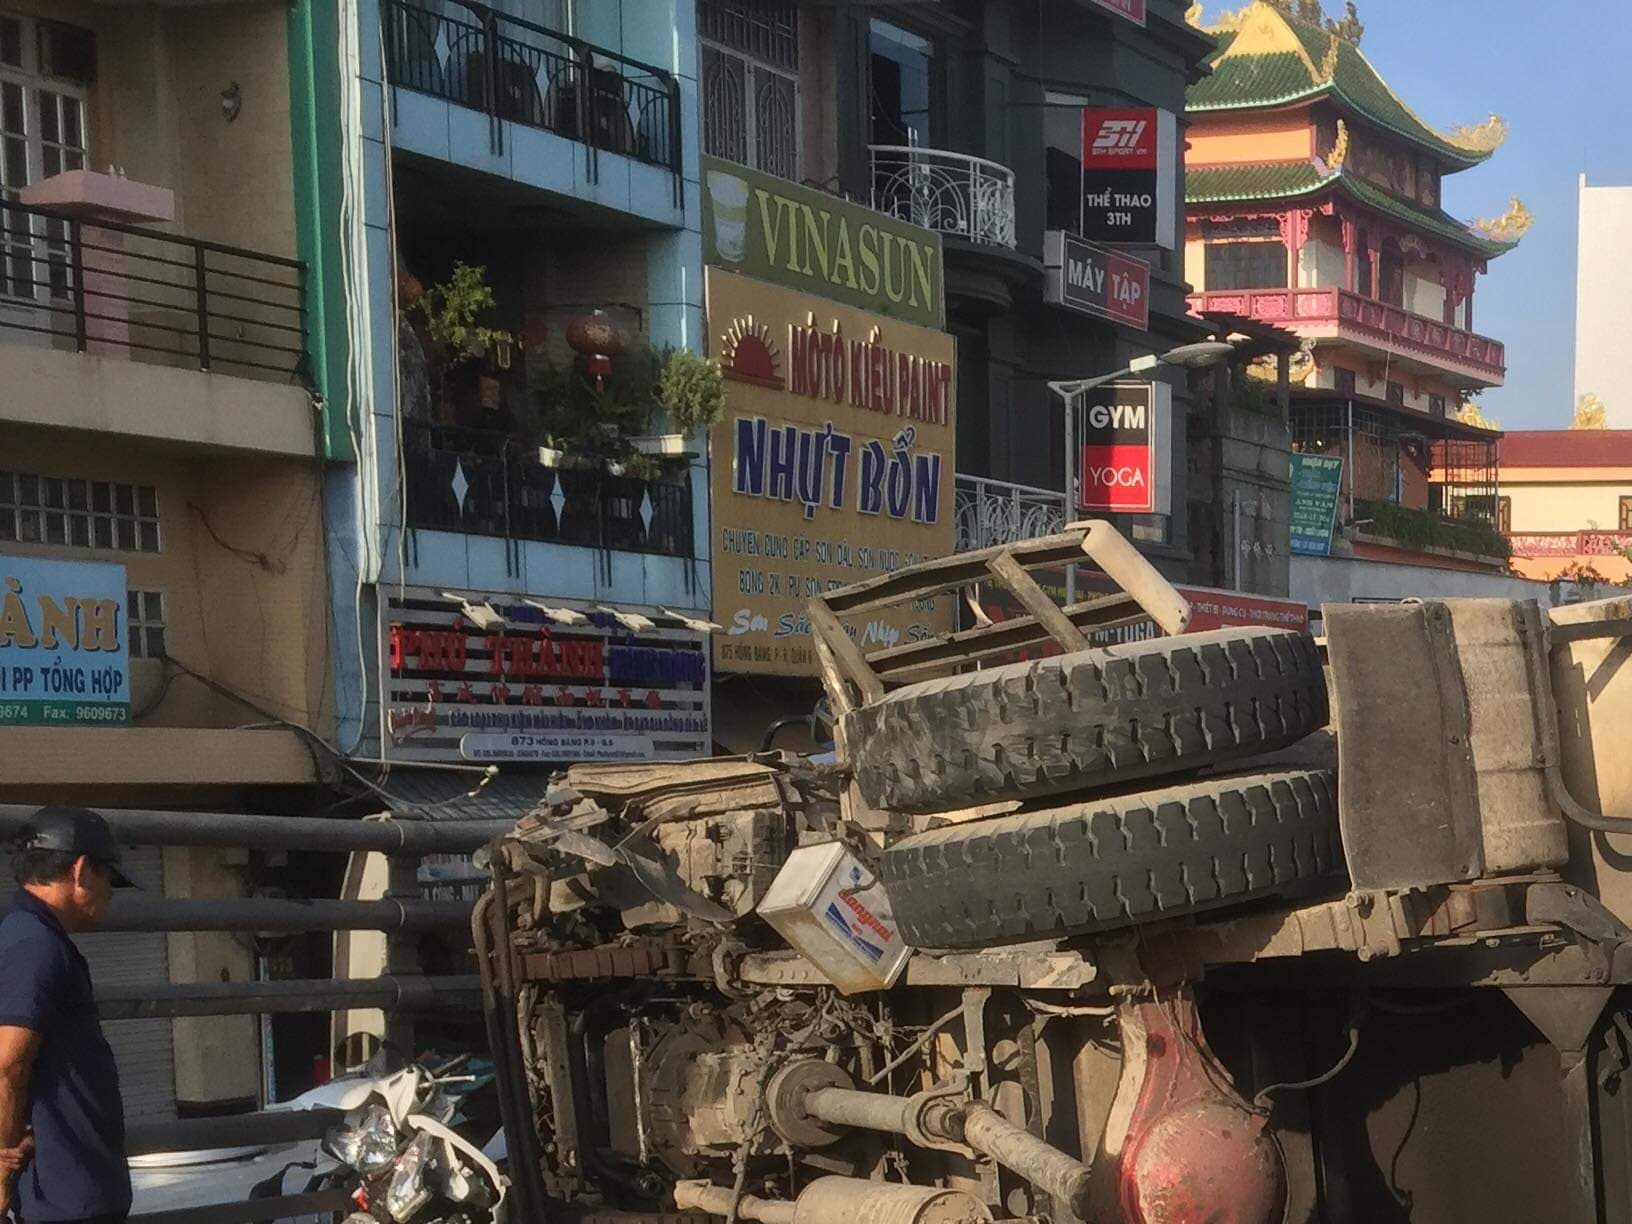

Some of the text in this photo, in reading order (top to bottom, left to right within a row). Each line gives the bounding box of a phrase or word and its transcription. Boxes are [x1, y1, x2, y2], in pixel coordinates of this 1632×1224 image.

[1087, 187, 1152, 207] THỂ THAO
[1107, 212, 1132, 225] 3TH
[755, 189, 934, 312] VINASUN
[1068, 258, 1141, 309] MÁY TẬP
[1089, 405, 1145, 429] GYM
[733, 416, 941, 524] NHỰT BỔN
[1090, 467, 1145, 486] YOGA
[13, 667, 33, 692] PP
[41, 656, 85, 693] TỔNG
[91, 665, 122, 700] HỢP
[43, 706, 70, 719] Fax:
[76, 706, 126, 720] 9609673
[511, 735, 534, 746] 873
